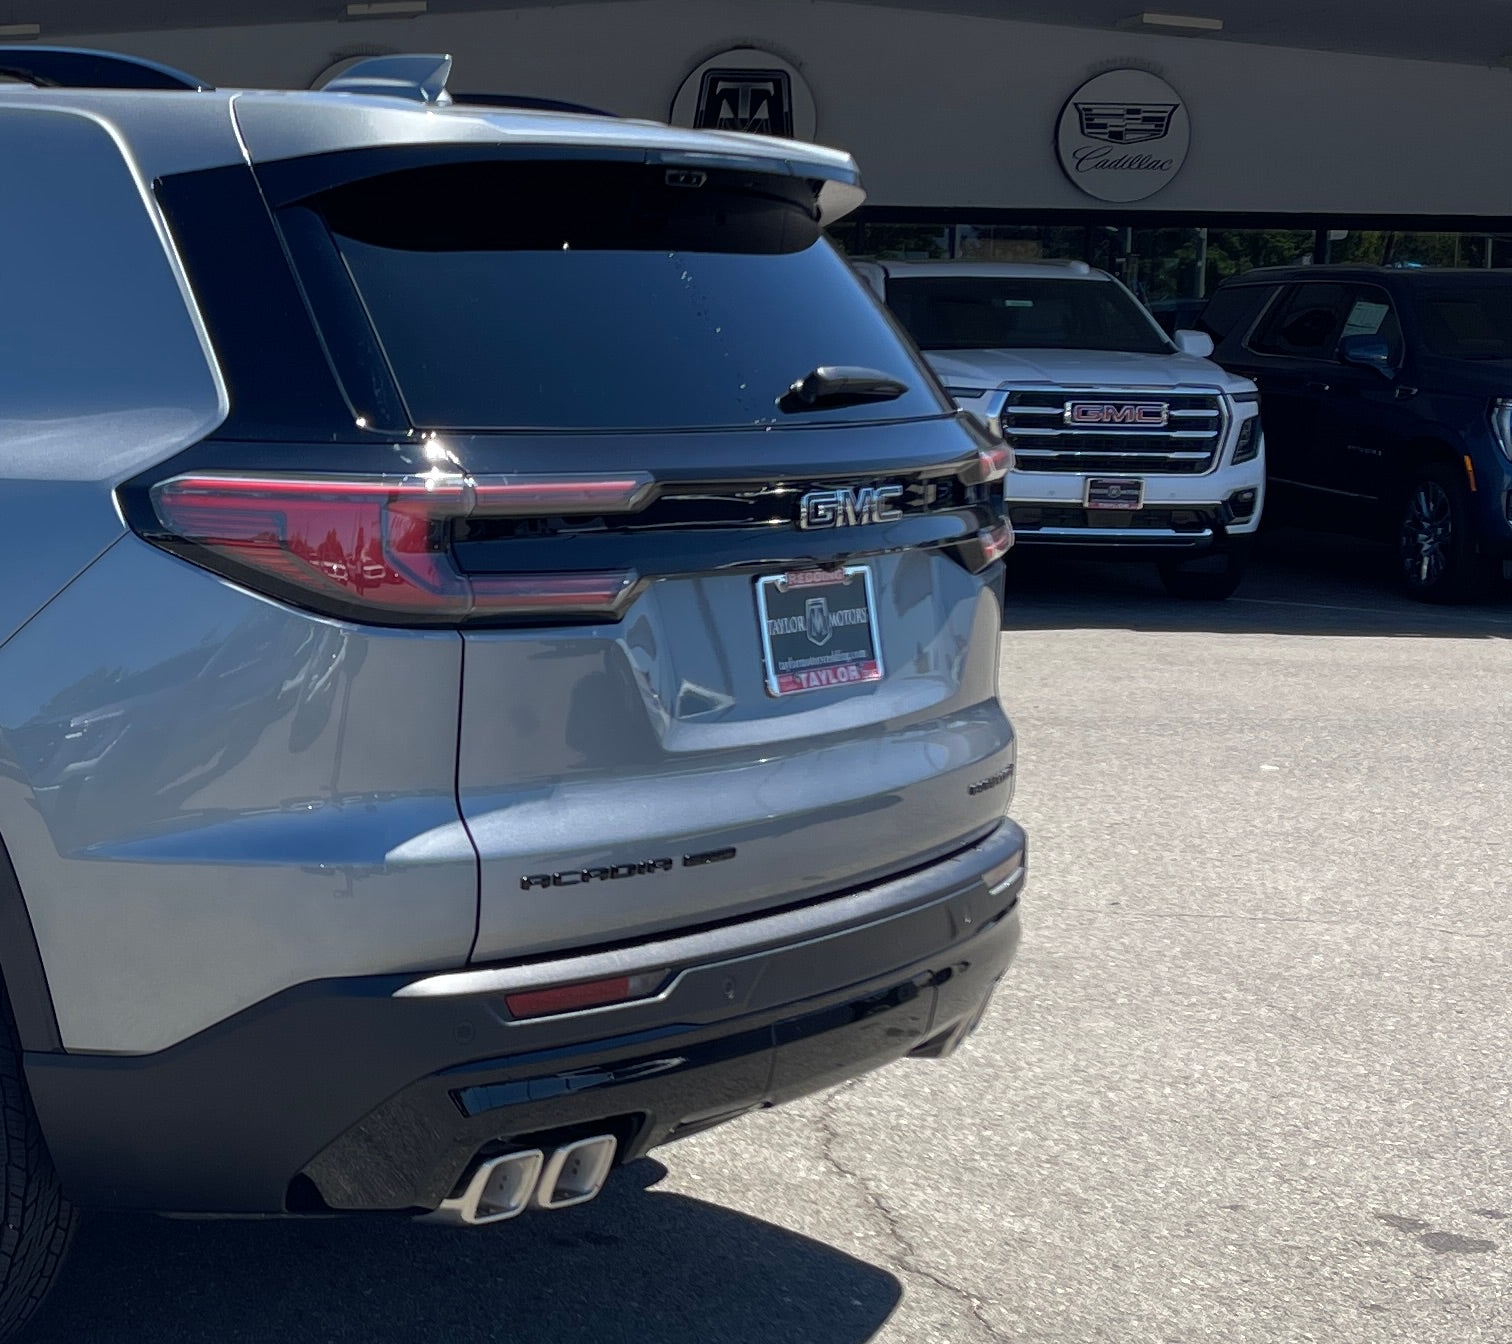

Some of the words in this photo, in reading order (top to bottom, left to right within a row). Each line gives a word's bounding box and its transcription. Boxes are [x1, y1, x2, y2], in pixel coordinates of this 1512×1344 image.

[1072, 145, 1174, 173] Cadillac
[1073, 404, 1163, 423] GMC
[800, 485, 904, 530] GMC
[768, 616, 807, 636] TAYLOR
[829, 608, 868, 627] MOTORS
[799, 666, 861, 688] TAYLOR
[520, 857, 673, 891] ACADIA
